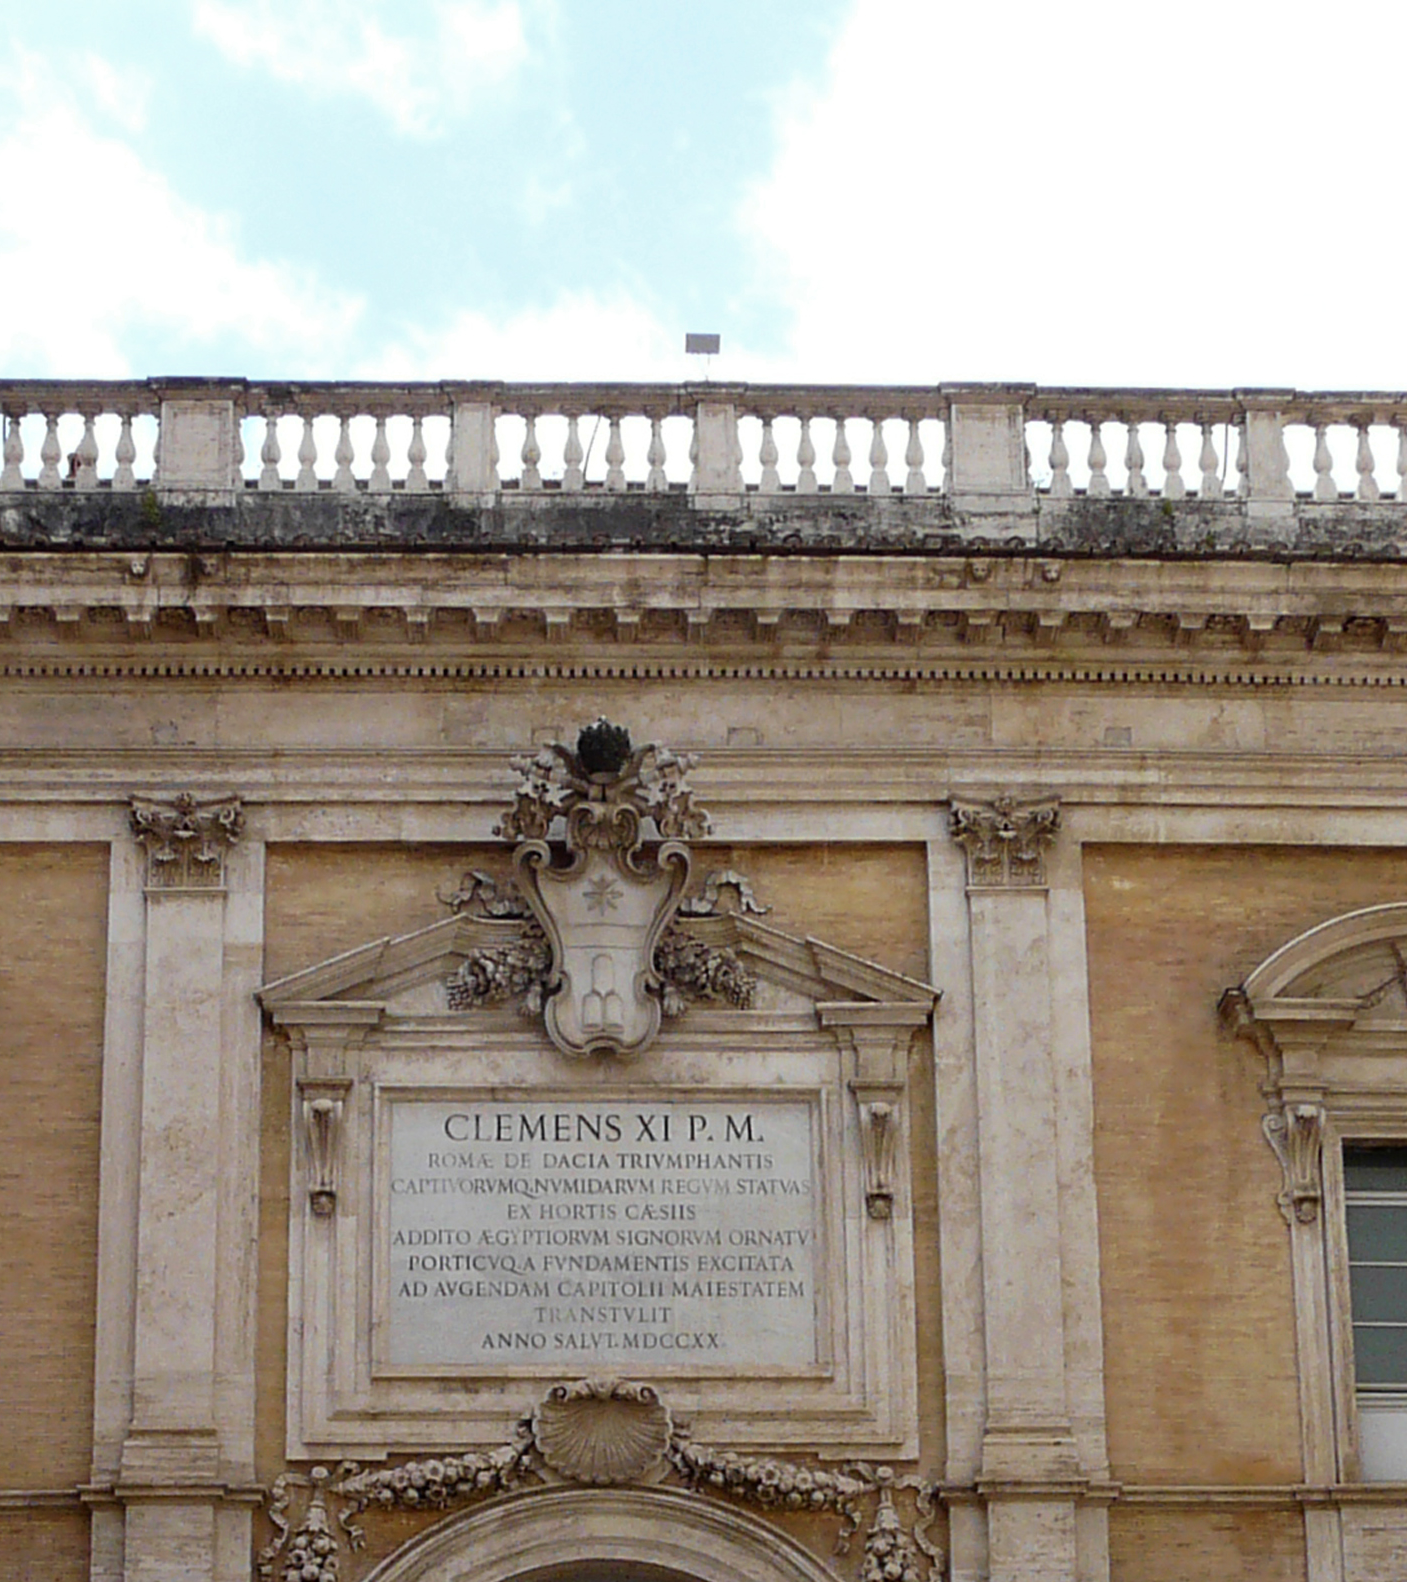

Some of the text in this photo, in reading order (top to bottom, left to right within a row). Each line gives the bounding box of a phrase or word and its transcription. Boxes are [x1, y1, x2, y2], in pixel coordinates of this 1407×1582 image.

[444, 1113, 764, 1142] CLEMENS XI P. M.
[428, 1152, 774, 1170] ROMÆ DE DACIA TRIVMPHANTIS
[662, 1178, 730, 1195] REGVM
[737, 1178, 811, 1195] STATVAS
[508, 1203, 697, 1220] EX HORTIS CÆSIIS
[393, 1230, 471, 1246] ADDITO
[616, 1230, 722, 1246] SIGNORVM
[728, 1230, 810, 1246] ORNATV
[544, 1255, 689, 1272] FVNDAMENTIS
[697, 1255, 794, 1272] EXCITATA
[398, 1281, 805, 1298] AD AVGENDAM CAPITOLII MAIESTATEM
[534, 1306, 672, 1323] TRANSTVLIT
[481, 1333, 547, 1349] ANNO
